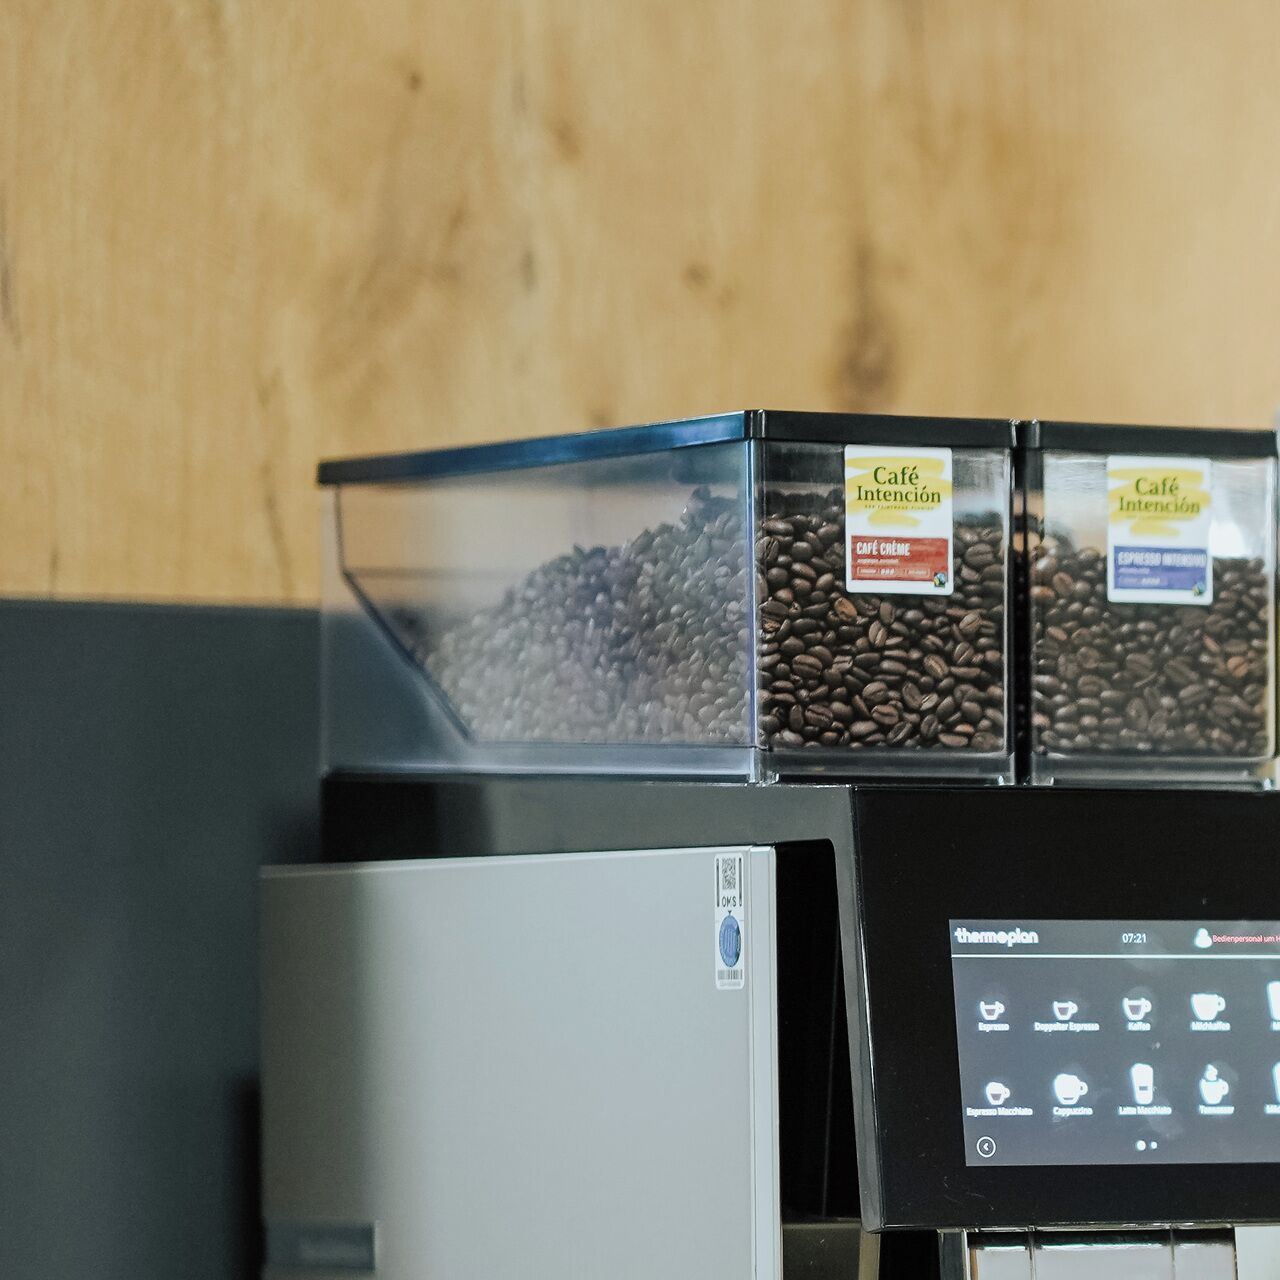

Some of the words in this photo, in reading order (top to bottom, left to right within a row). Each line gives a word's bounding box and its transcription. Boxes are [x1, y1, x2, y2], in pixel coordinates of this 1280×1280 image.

[873, 465, 919, 486] Café
[857, 485, 941, 504] Intención
[1135, 477, 1180, 497] Café
[1119, 495, 1201, 514] Intención
[856, 539, 878, 555] CAFÉ
[954, 927, 1039, 947] thermoplan
[1122, 932, 1147, 944] 07:21
[1212, 934, 1263, 944] Bedienpersonal
